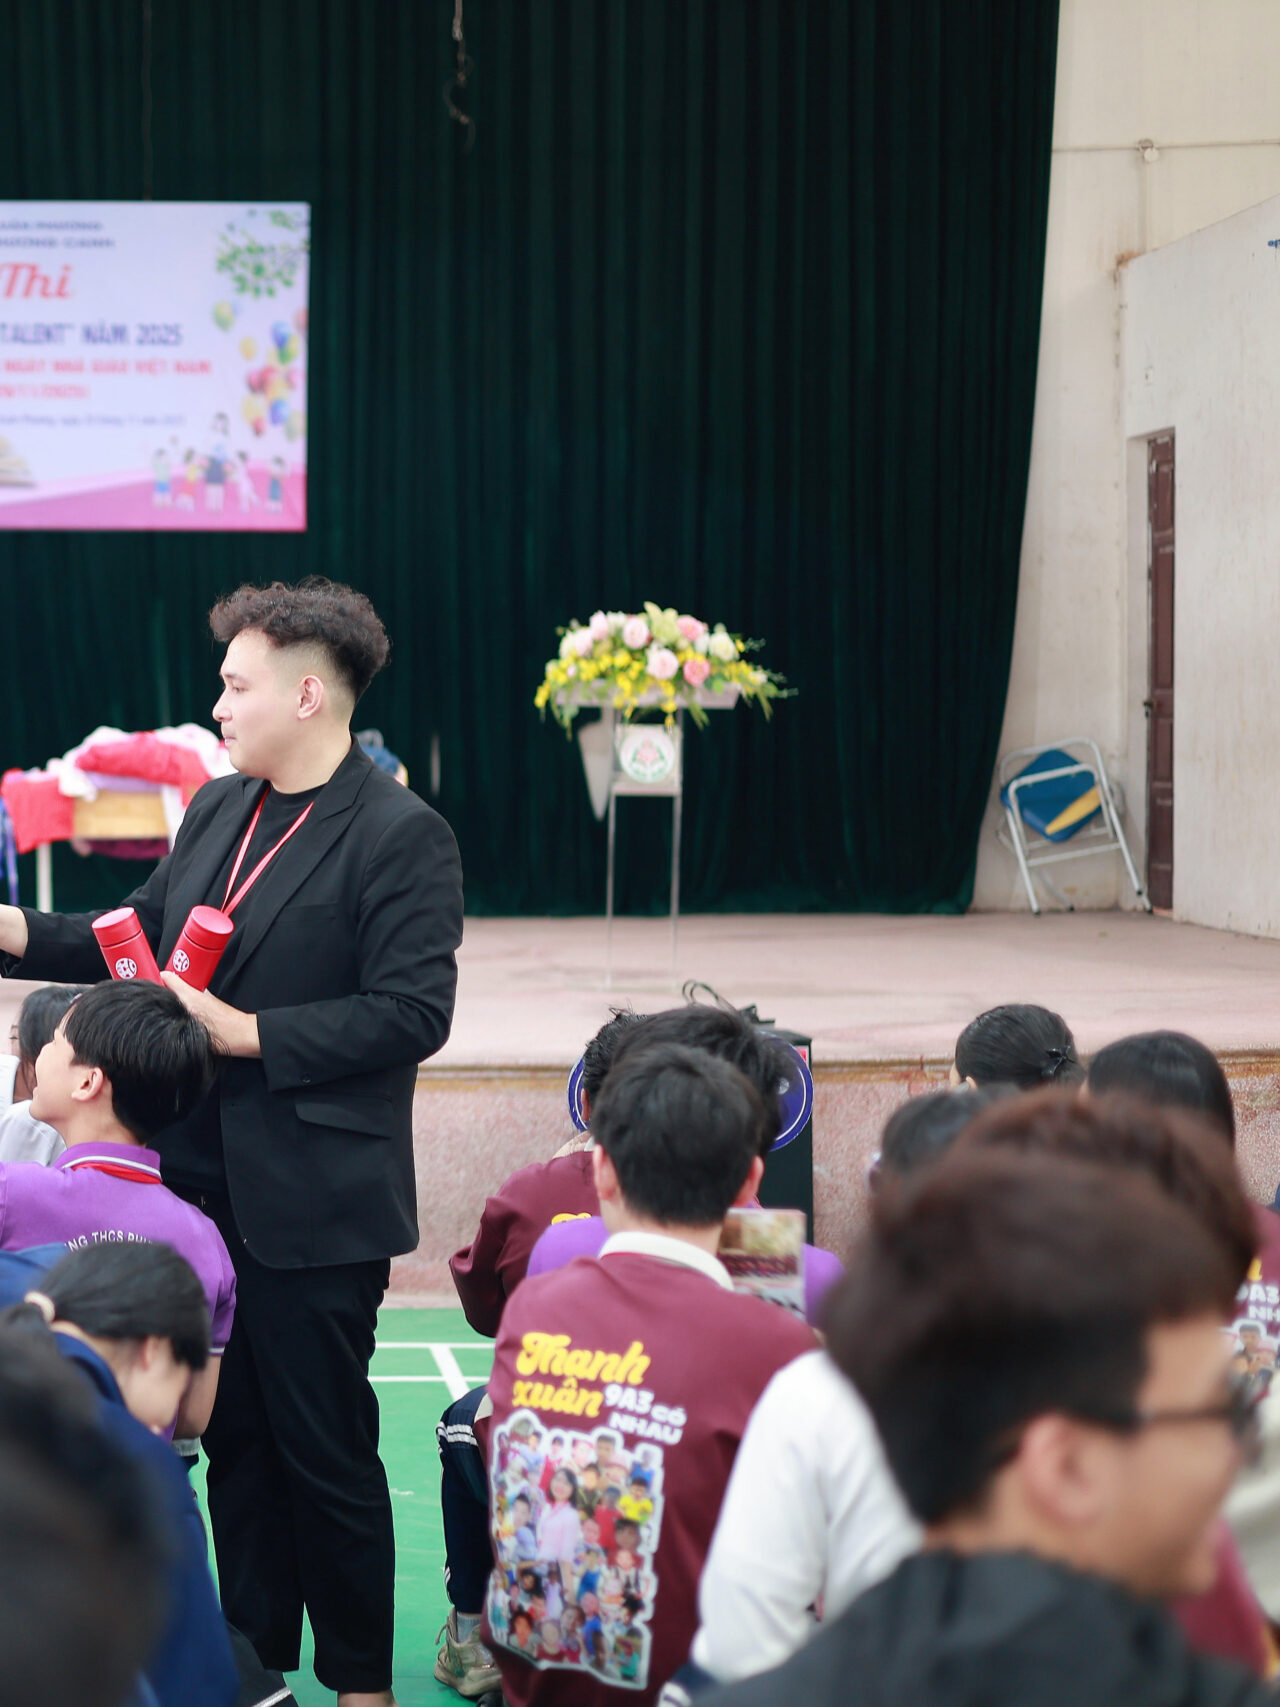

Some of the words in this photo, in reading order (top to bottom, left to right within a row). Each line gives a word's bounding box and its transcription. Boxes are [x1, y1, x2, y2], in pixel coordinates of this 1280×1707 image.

[137, 323, 181, 346] 2025
[64, 1234, 88, 1252] NG
[91, 1229, 124, 1244] THCS
[516, 1332, 651, 1385] Thanh
[512, 1375, 604, 1418] xuân
[604, 1383, 655, 1415] 9A3
[608, 1411, 683, 1446] NHAU
